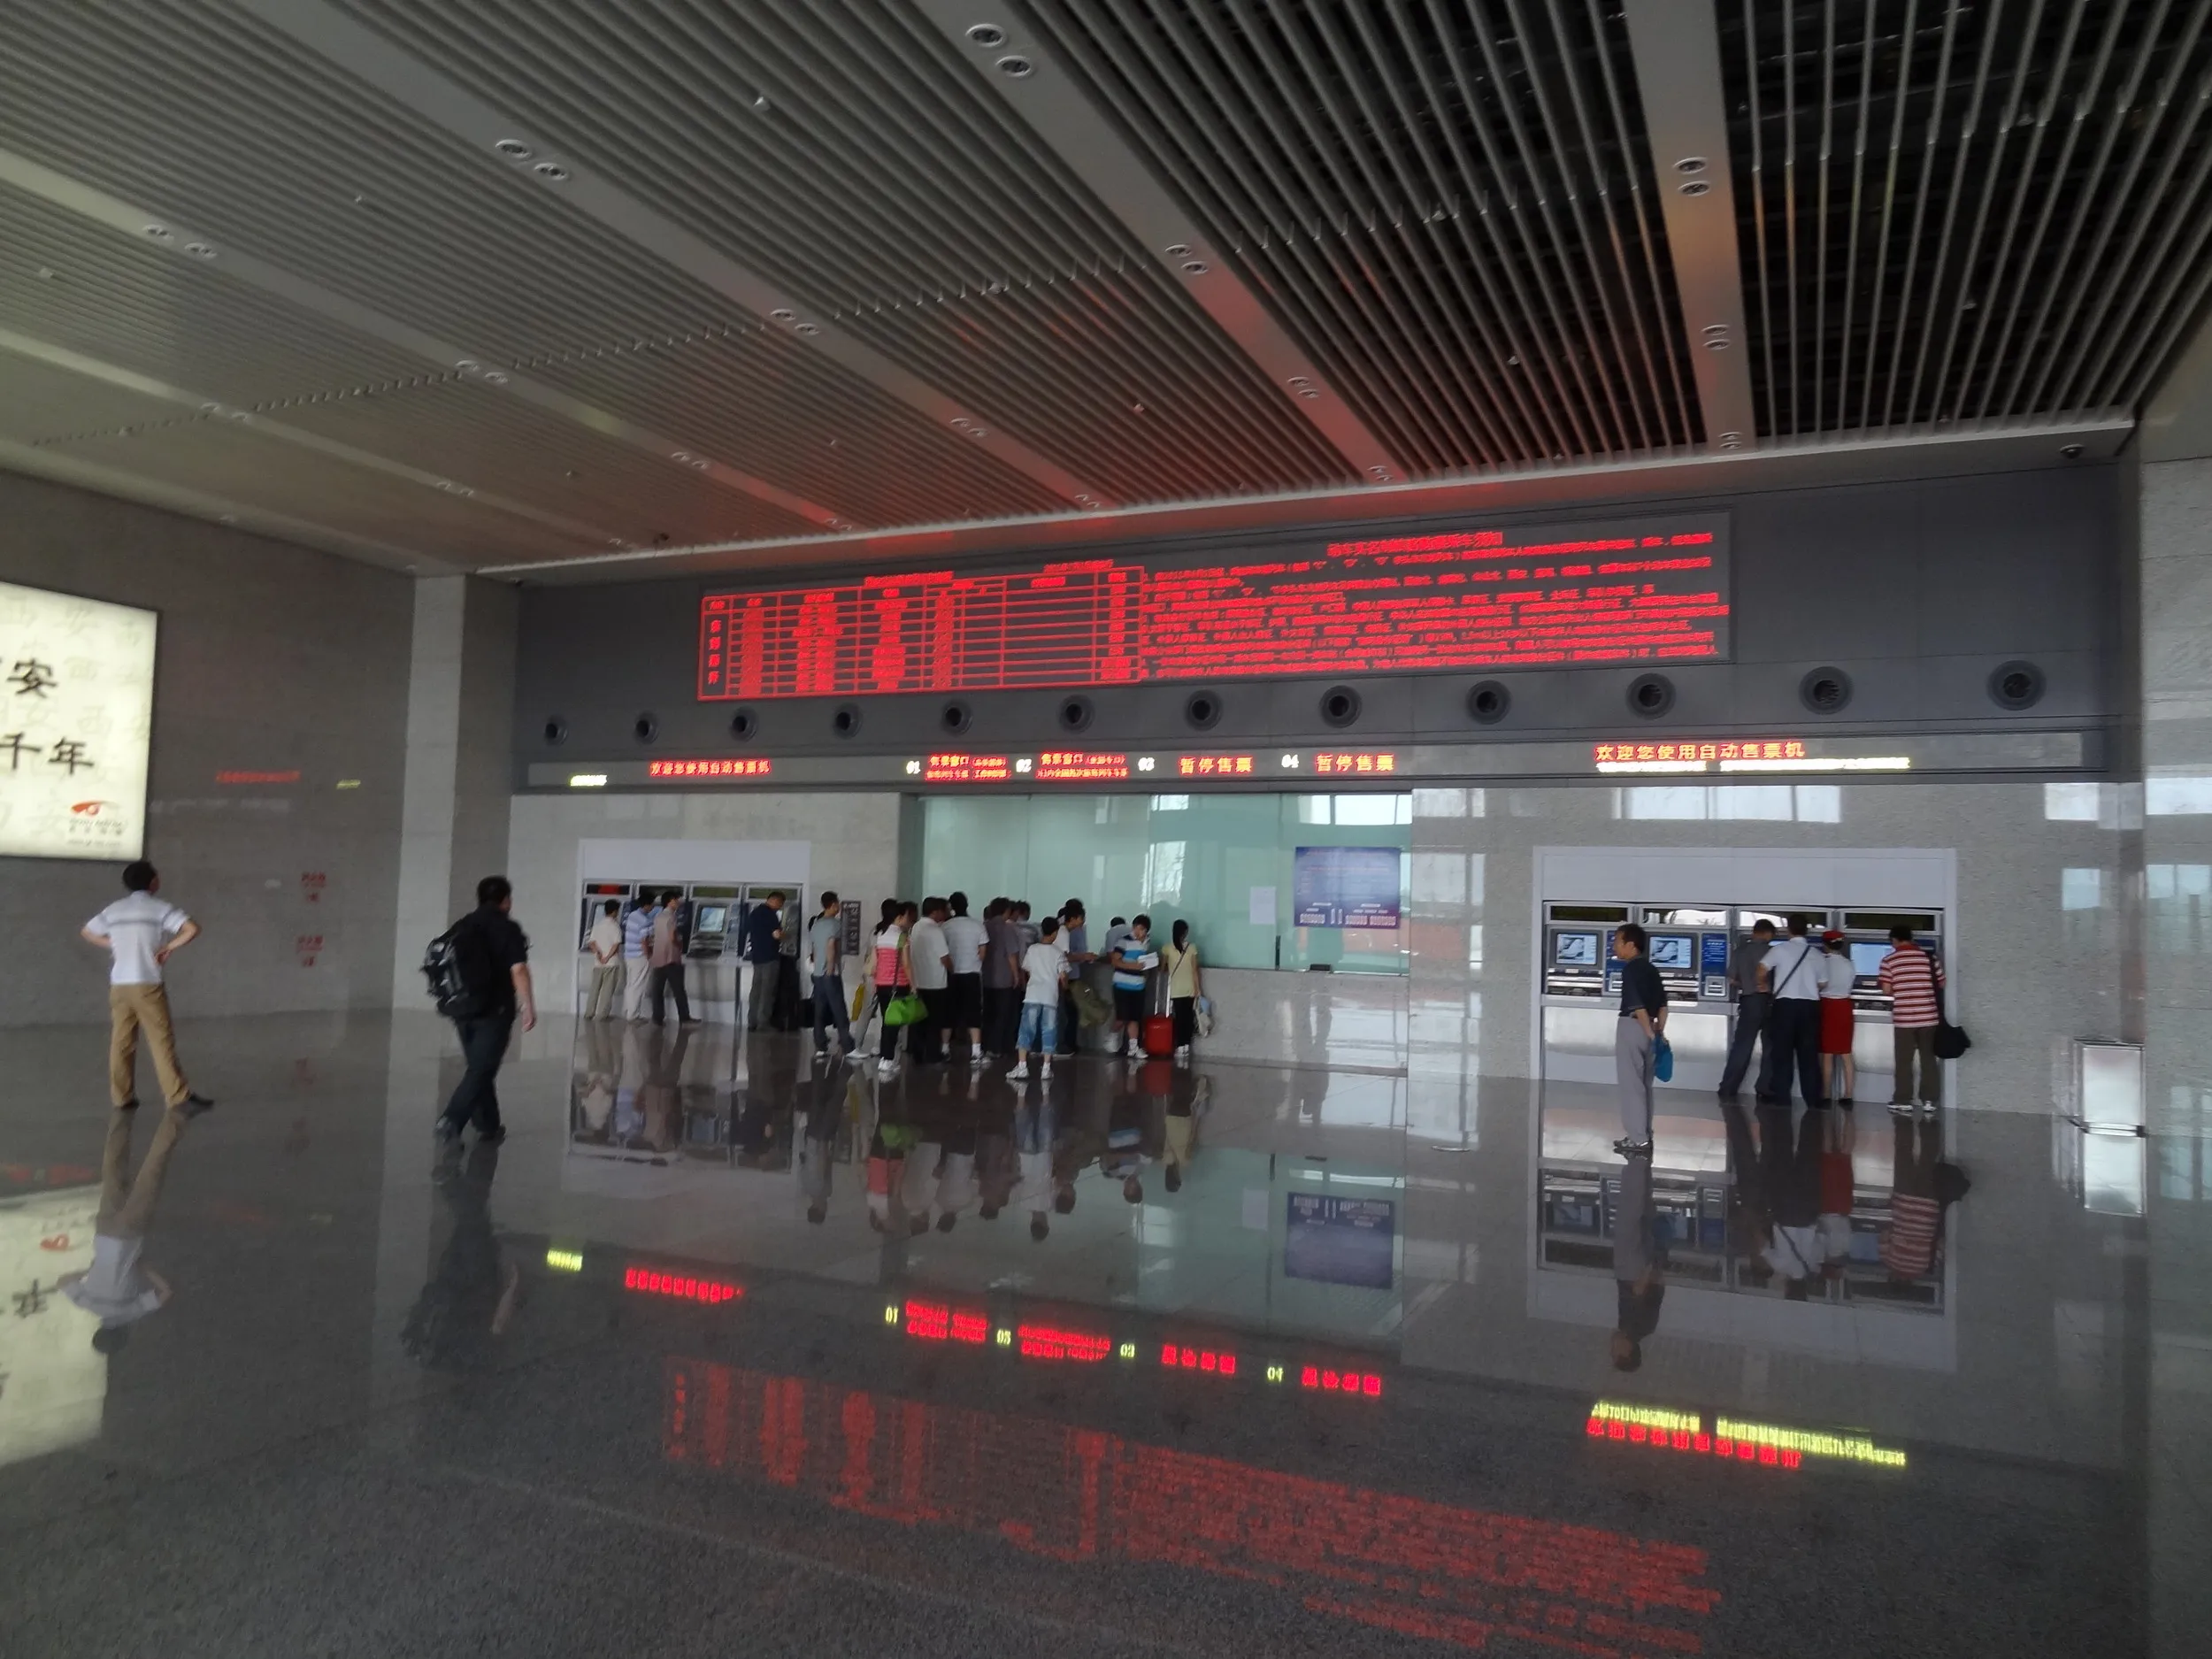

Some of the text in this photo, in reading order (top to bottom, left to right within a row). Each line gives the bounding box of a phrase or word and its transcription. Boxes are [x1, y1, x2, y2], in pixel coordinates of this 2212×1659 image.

[0, 657, 58, 699] 安
[1596, 742, 1805, 760] 欢迎您使用自动售票机
[1179, 757, 1253, 774] 暂停售票
[1316, 755, 1394, 772] 暂停售票
